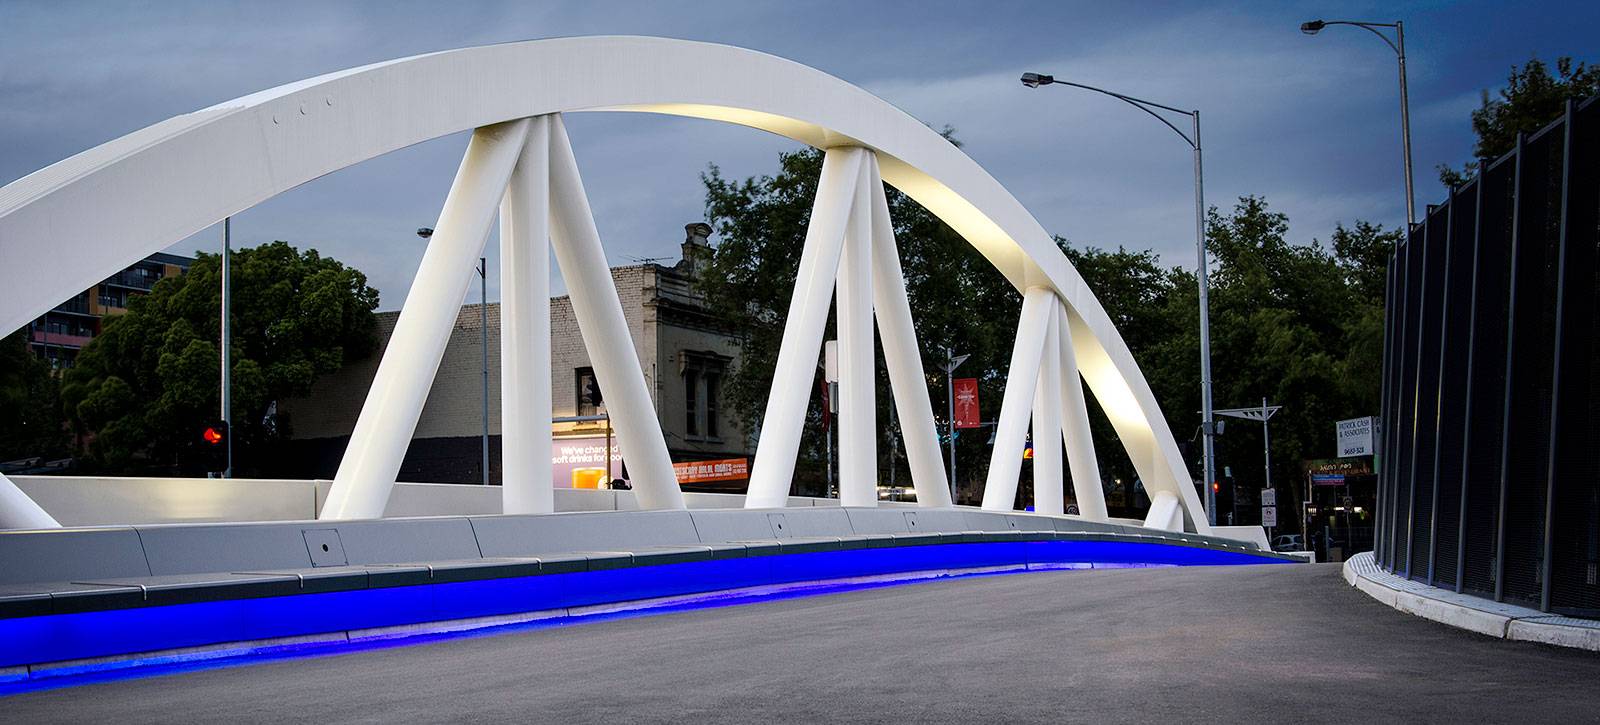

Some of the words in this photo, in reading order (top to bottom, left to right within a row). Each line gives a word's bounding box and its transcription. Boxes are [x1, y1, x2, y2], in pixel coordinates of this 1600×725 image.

[561, 445, 584, 455] We've
[552, 455, 569, 464] soft
[569, 454, 593, 464] drinks
[594, 453, 604, 462] for
